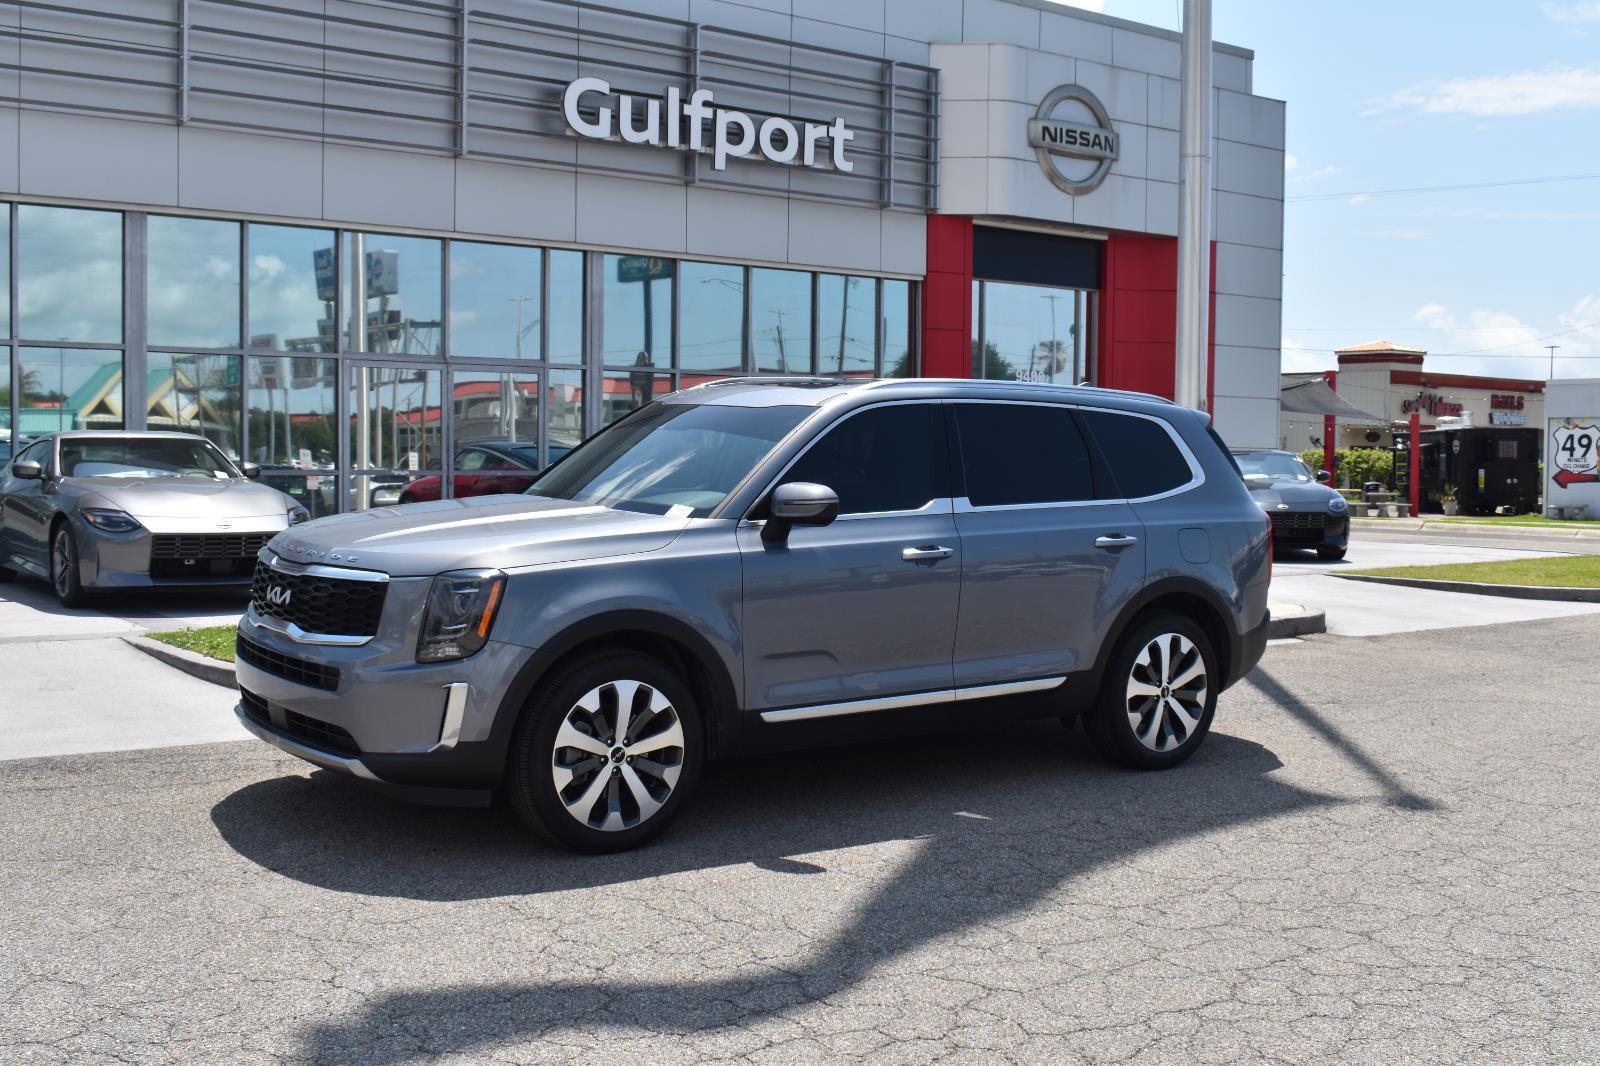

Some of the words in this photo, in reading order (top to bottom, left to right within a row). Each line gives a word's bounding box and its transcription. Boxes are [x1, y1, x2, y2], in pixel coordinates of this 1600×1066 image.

[563, 77, 854, 172] Gulfport
[1041, 125, 1114, 154] NISSAN
[1561, 433, 1593, 458] 49
